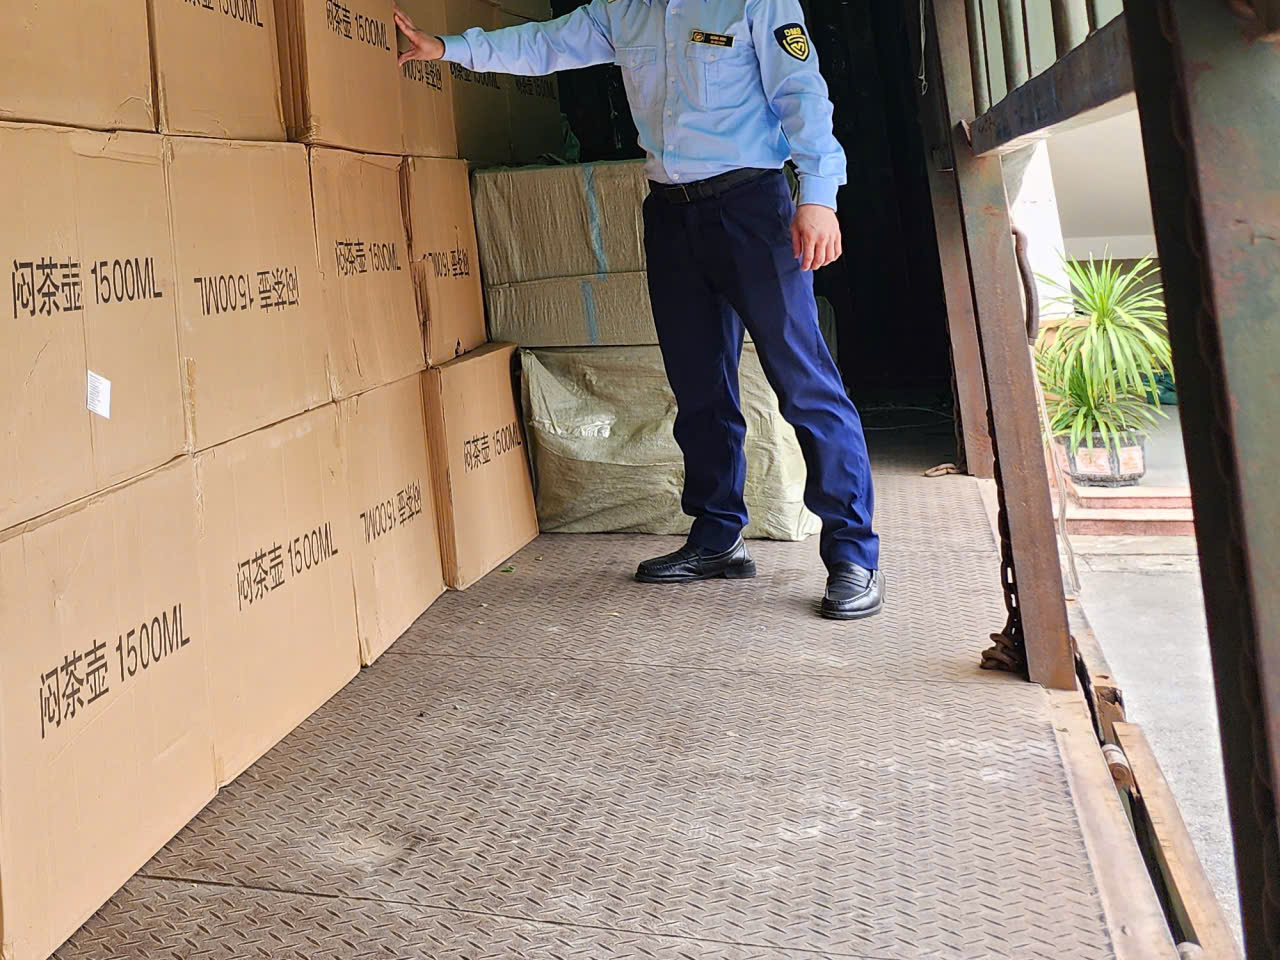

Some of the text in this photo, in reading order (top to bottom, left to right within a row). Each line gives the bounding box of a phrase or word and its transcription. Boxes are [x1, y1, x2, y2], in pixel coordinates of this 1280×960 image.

[354, 12, 391, 52] 1500ML
[369, 241, 402, 272] 1500ML
[12, 255, 163, 320] 闷茶壶 1500ML
[193, 266, 300, 316] 闷茶壶 1500ML
[360, 497, 397, 545] 1500ML
[237, 520, 339, 612] 闷茶壶 1500ML
[39, 602, 191, 740] 闷茶壶 1500ML
